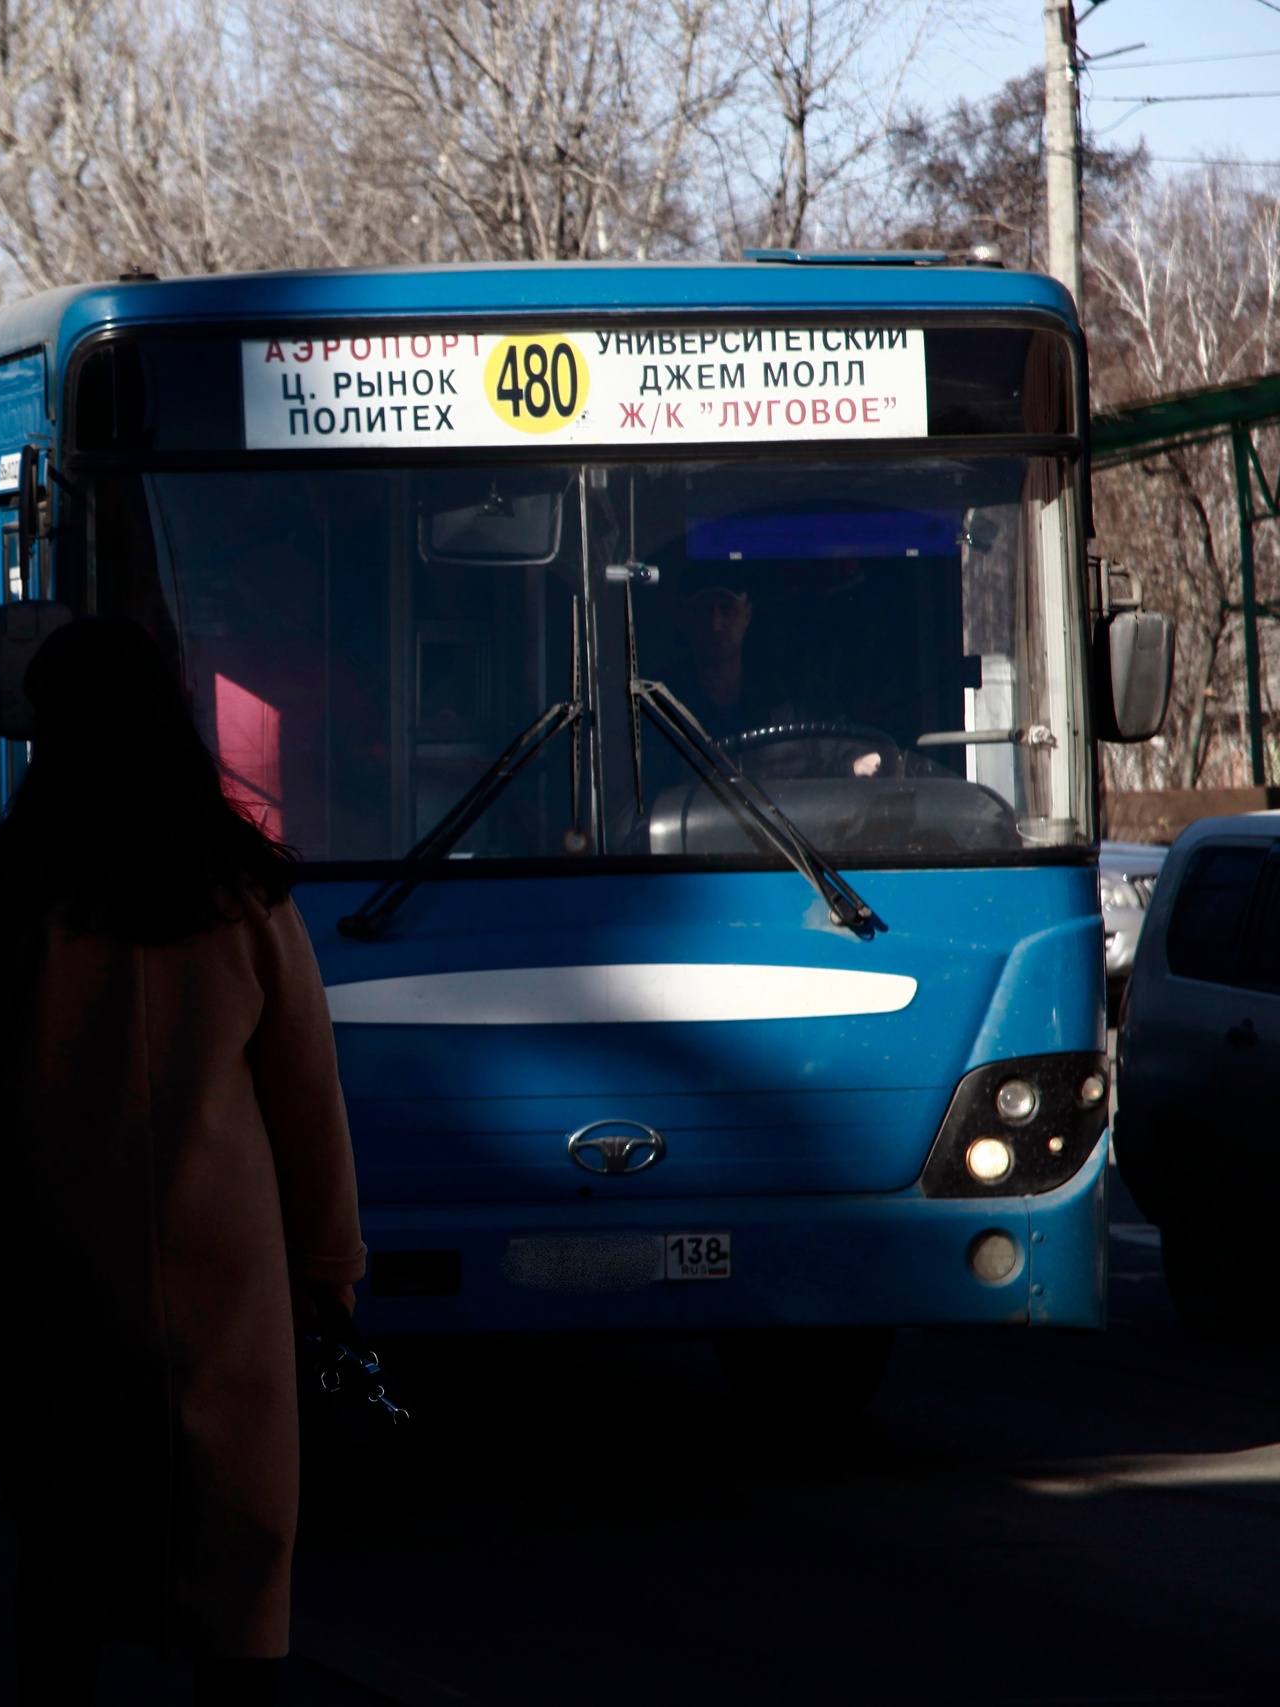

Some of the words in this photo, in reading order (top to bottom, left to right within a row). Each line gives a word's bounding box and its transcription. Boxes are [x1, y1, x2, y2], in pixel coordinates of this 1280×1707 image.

[265, 332, 485, 363] АЭРОПОРТ
[281, 373, 316, 405] Ц.
[333, 368, 459, 399] РЫНОК
[497, 342, 578, 419] 480
[639, 362, 746, 397] ДЖЕМ
[763, 359, 866, 389] МОЛЛ
[289, 404, 456, 436] ПОЛИТЕХ
[618, 402, 685, 436] Ж/К
[670, 1237, 721, 1265] 138
[681, 1264, 707, 1276] RUS
